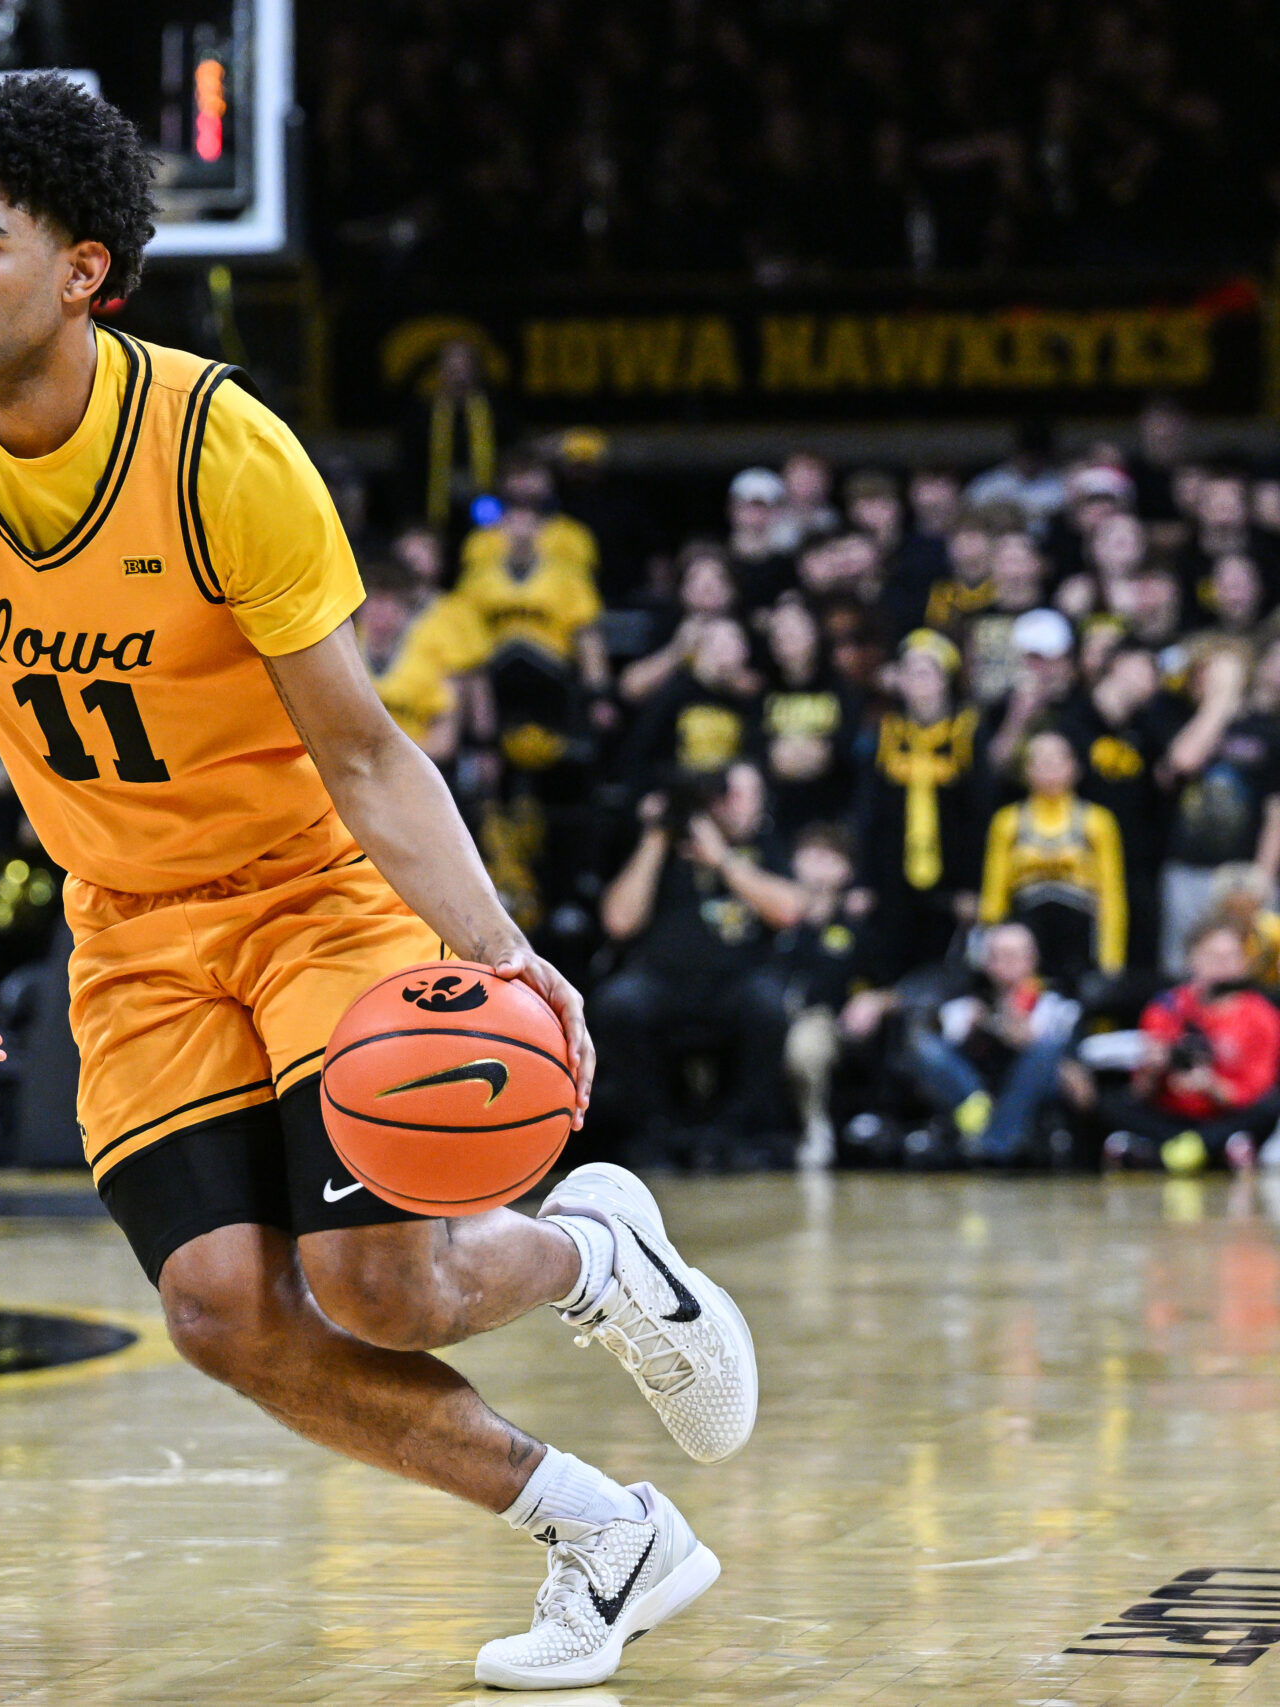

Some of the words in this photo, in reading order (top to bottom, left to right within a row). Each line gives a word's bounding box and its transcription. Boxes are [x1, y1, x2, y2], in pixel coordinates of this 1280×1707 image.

[523, 316, 740, 394] IOWA
[761, 309, 1212, 391] HAWKEYES
[11, 673, 172, 784] 11
